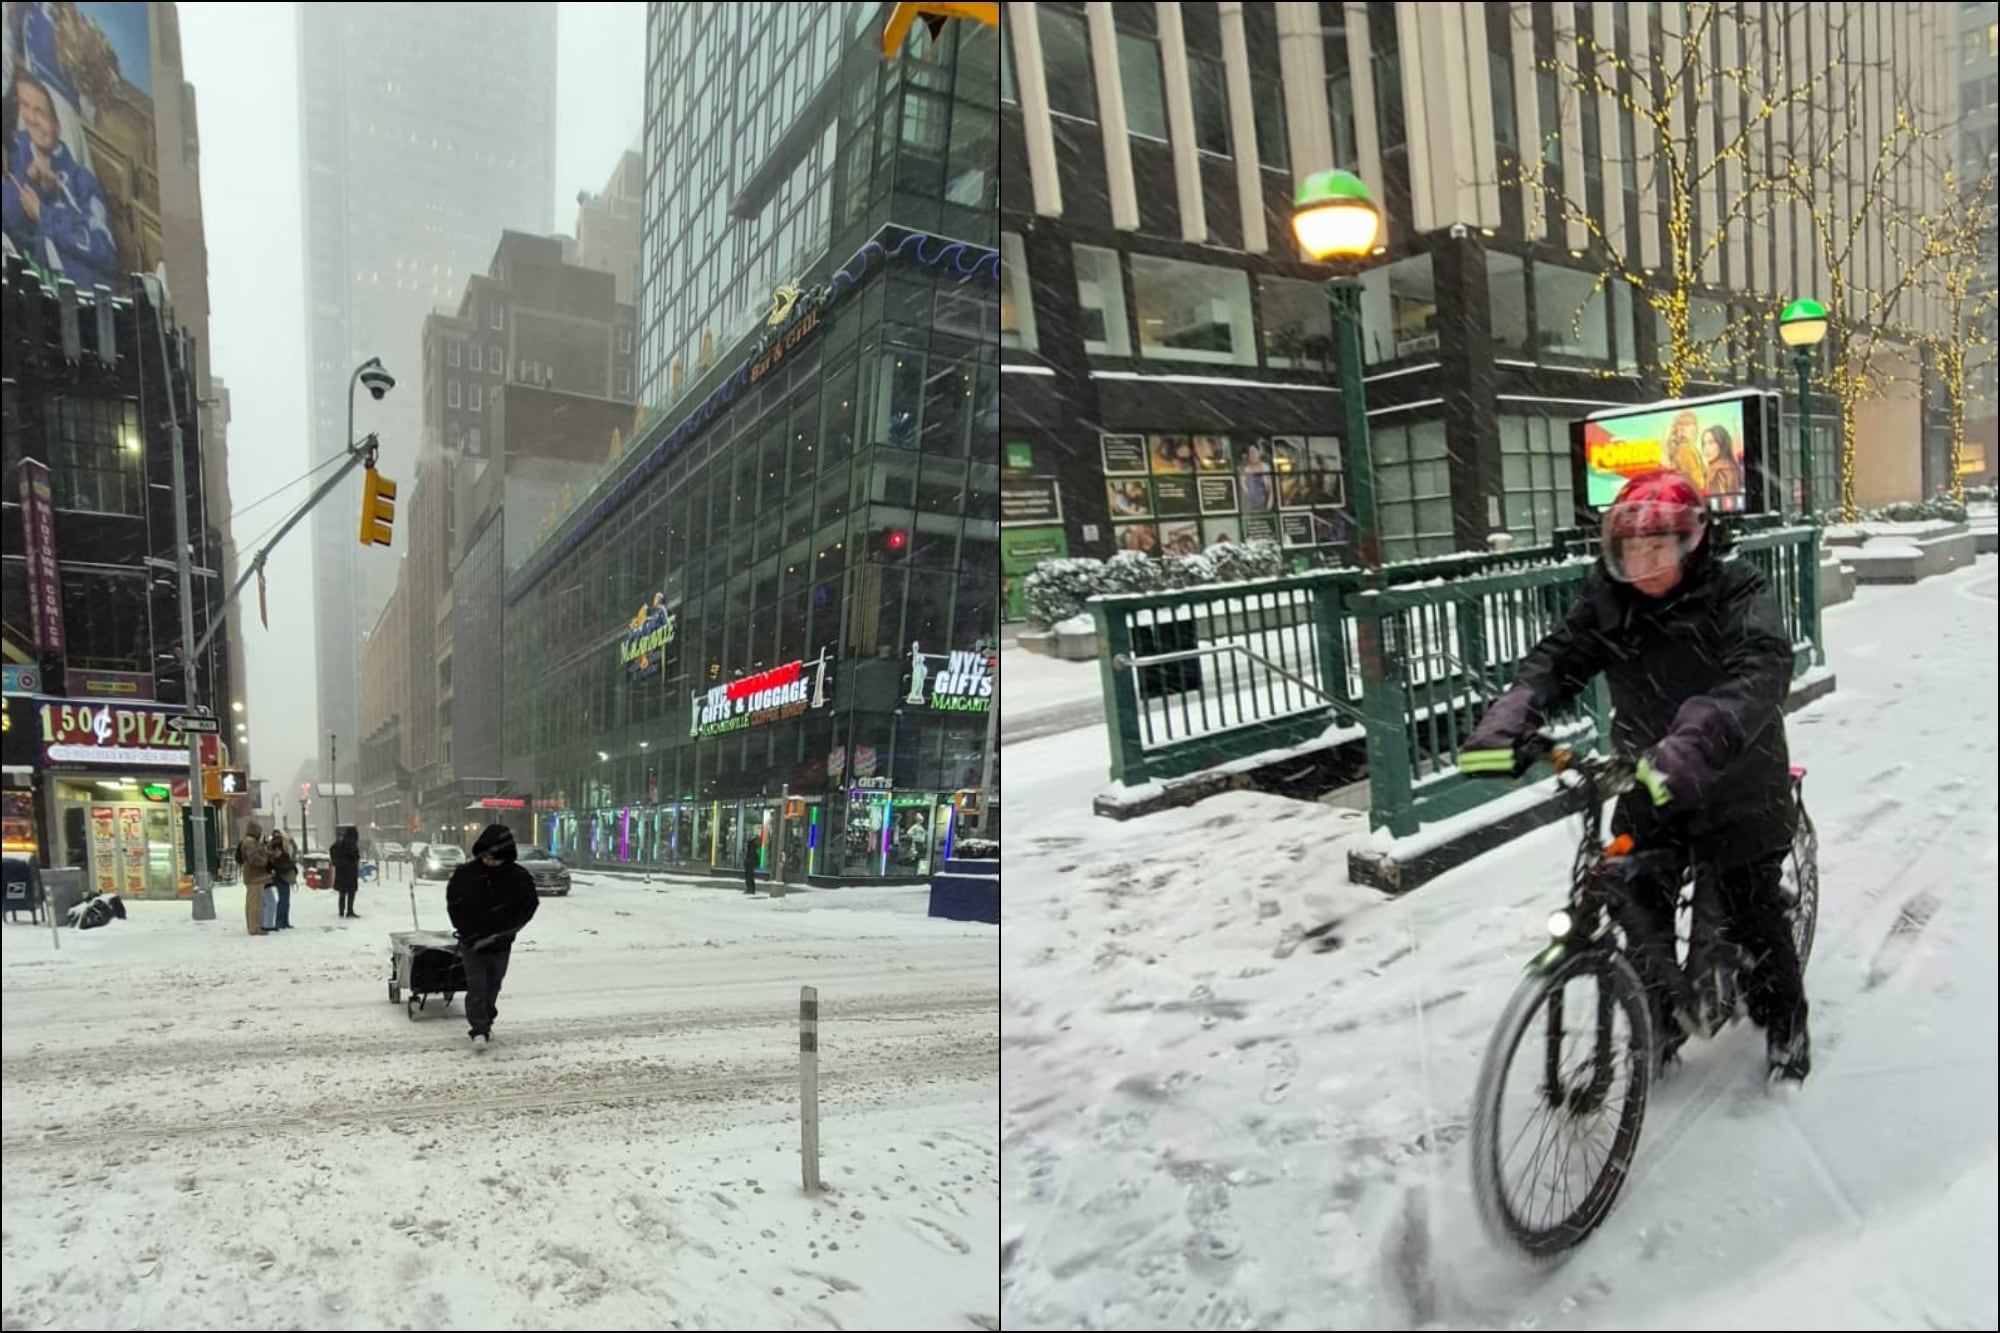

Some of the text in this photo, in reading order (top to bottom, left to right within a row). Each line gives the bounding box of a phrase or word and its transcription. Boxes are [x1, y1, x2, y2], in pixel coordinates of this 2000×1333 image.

[947, 650, 987, 677] NYC
[707, 683, 728, 707] NYC
[934, 670, 992, 697] GIFTS
[701, 699, 732, 726] GIFTS
[735, 698, 745, 713] &
[748, 676, 810, 713] LUGGAGE
[115, 710, 203, 747] PIZ
